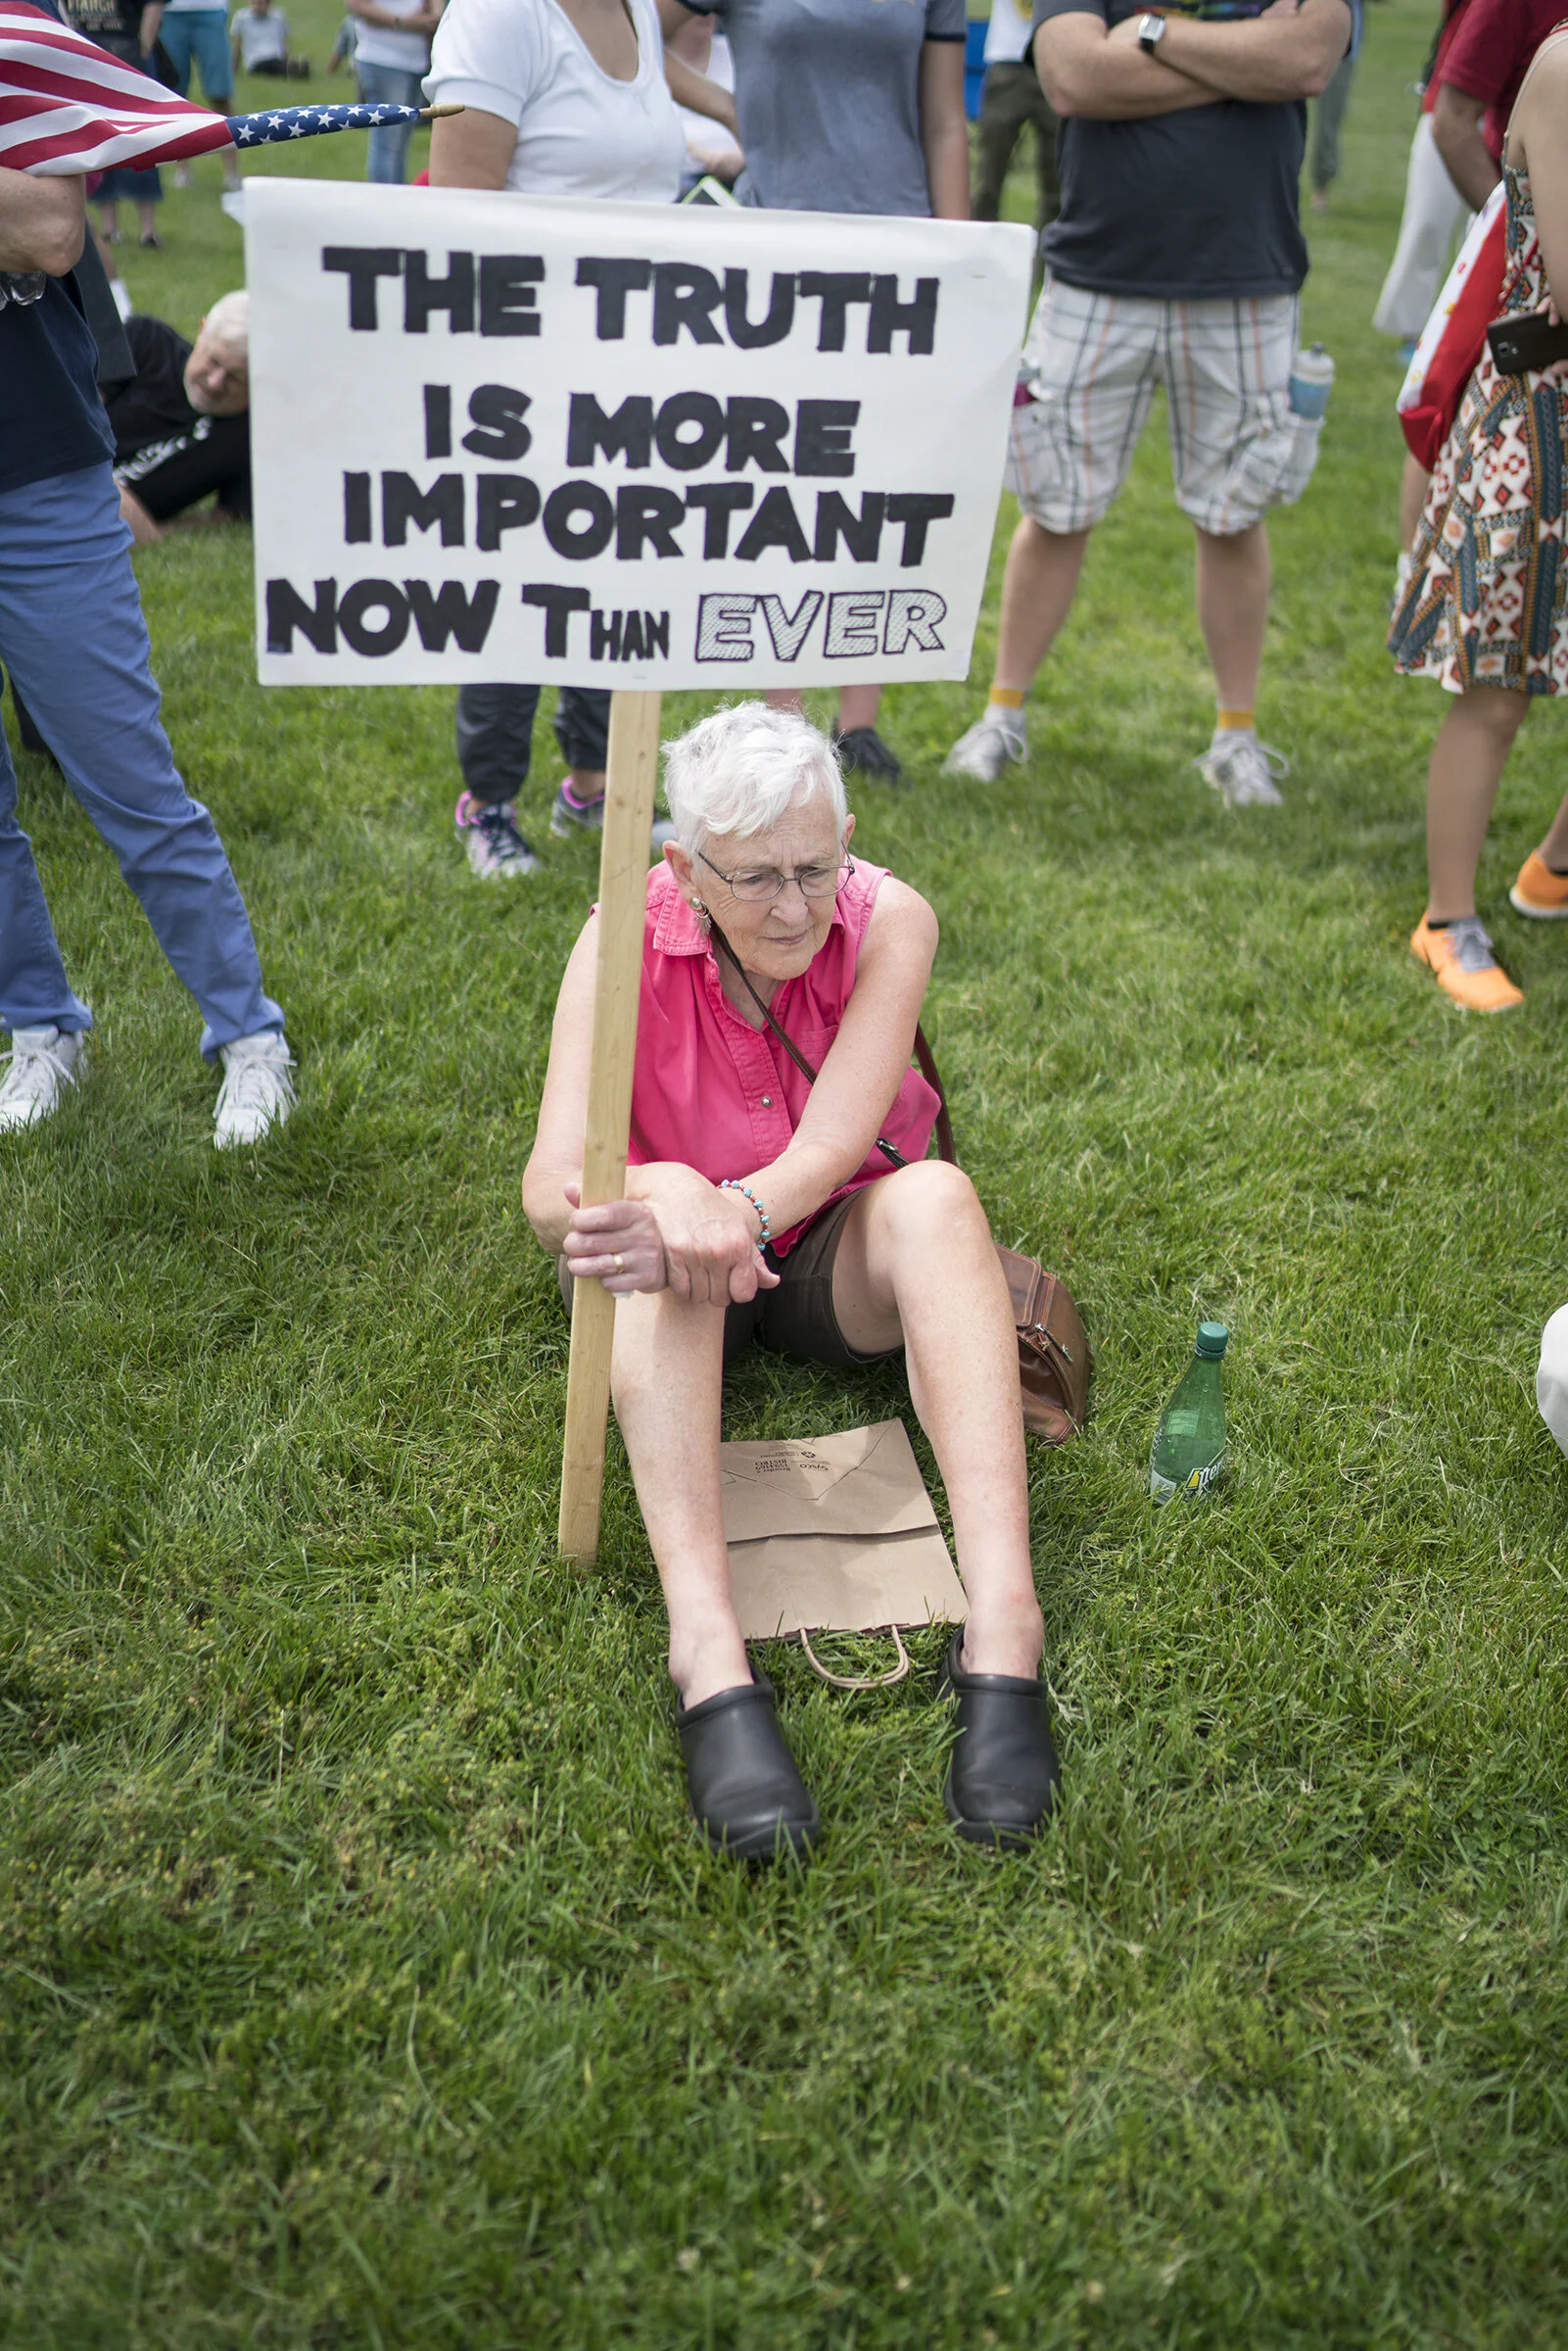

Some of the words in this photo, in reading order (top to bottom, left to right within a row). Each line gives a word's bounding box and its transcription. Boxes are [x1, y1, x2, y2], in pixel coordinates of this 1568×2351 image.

[323, 247, 546, 337] THE
[576, 256, 940, 356] TRUTH
[424, 385, 532, 461] IS
[567, 392, 861, 477] MORE
[344, 471, 955, 568] IMPORTANT
[266, 578, 500, 657] NOW
[695, 590, 947, 663] EVER
